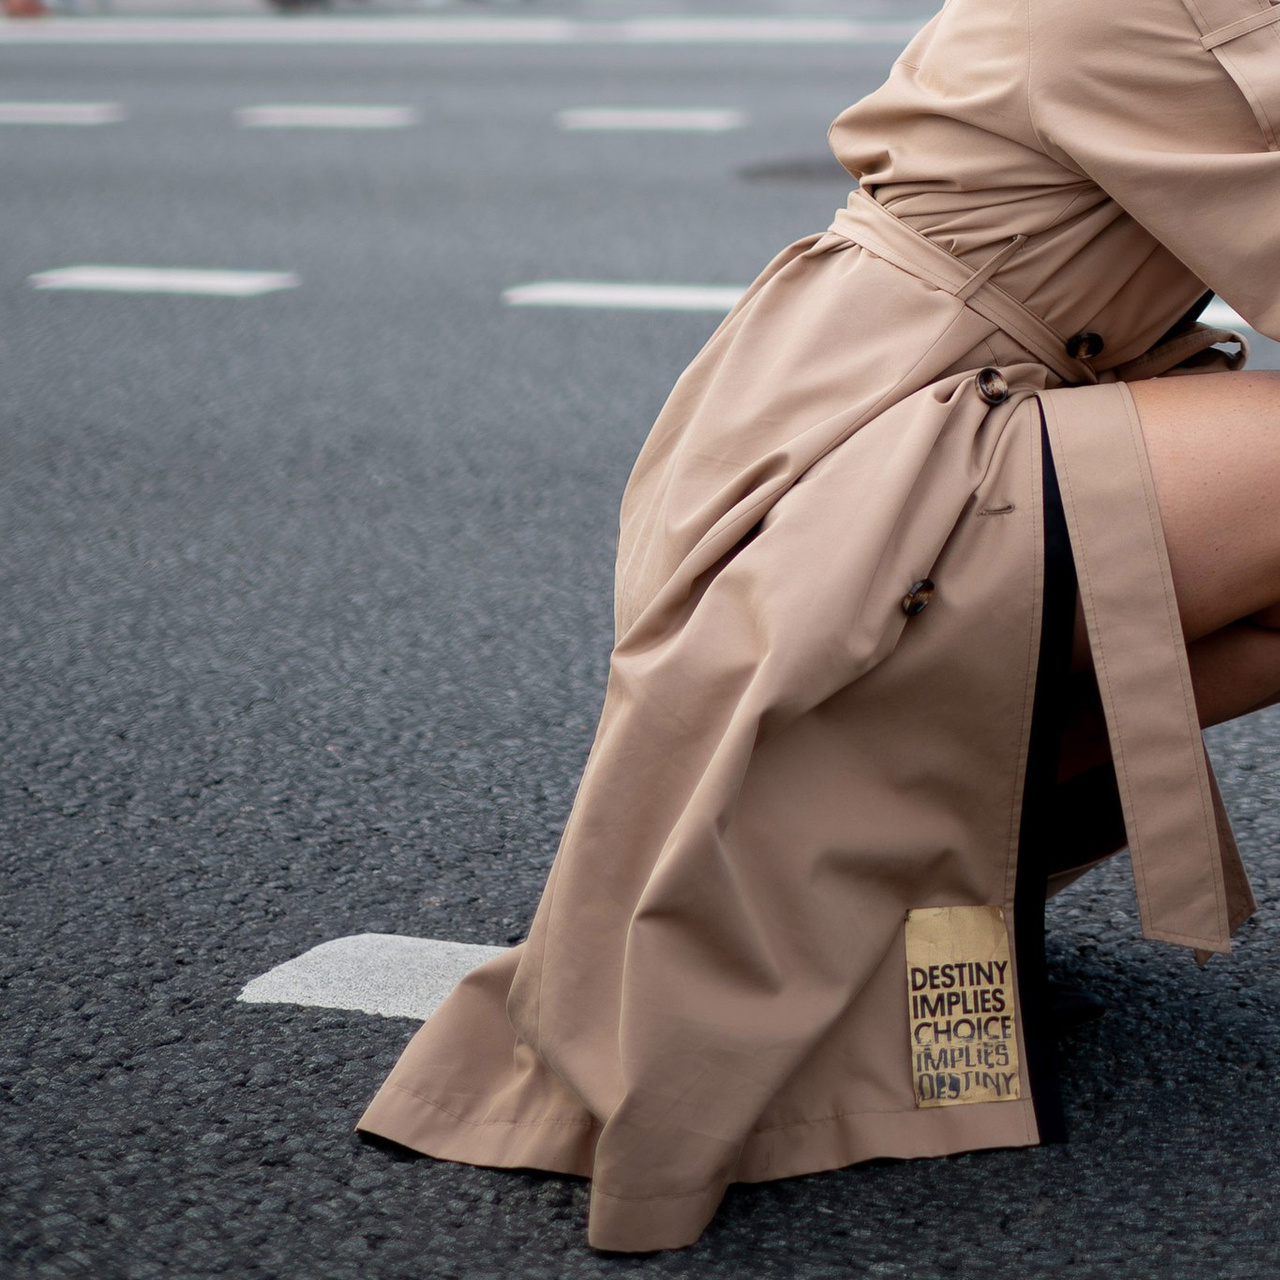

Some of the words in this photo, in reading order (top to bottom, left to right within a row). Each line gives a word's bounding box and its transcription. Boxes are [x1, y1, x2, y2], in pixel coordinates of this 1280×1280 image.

[911, 960, 1008, 991] DESTINY
[912, 988, 1006, 1019] IMPLIES
[914, 1016, 1012, 1045] CHOICE
[916, 1041, 1010, 1072] IMPLIES
[918, 1071, 1015, 1101] DESTINY
